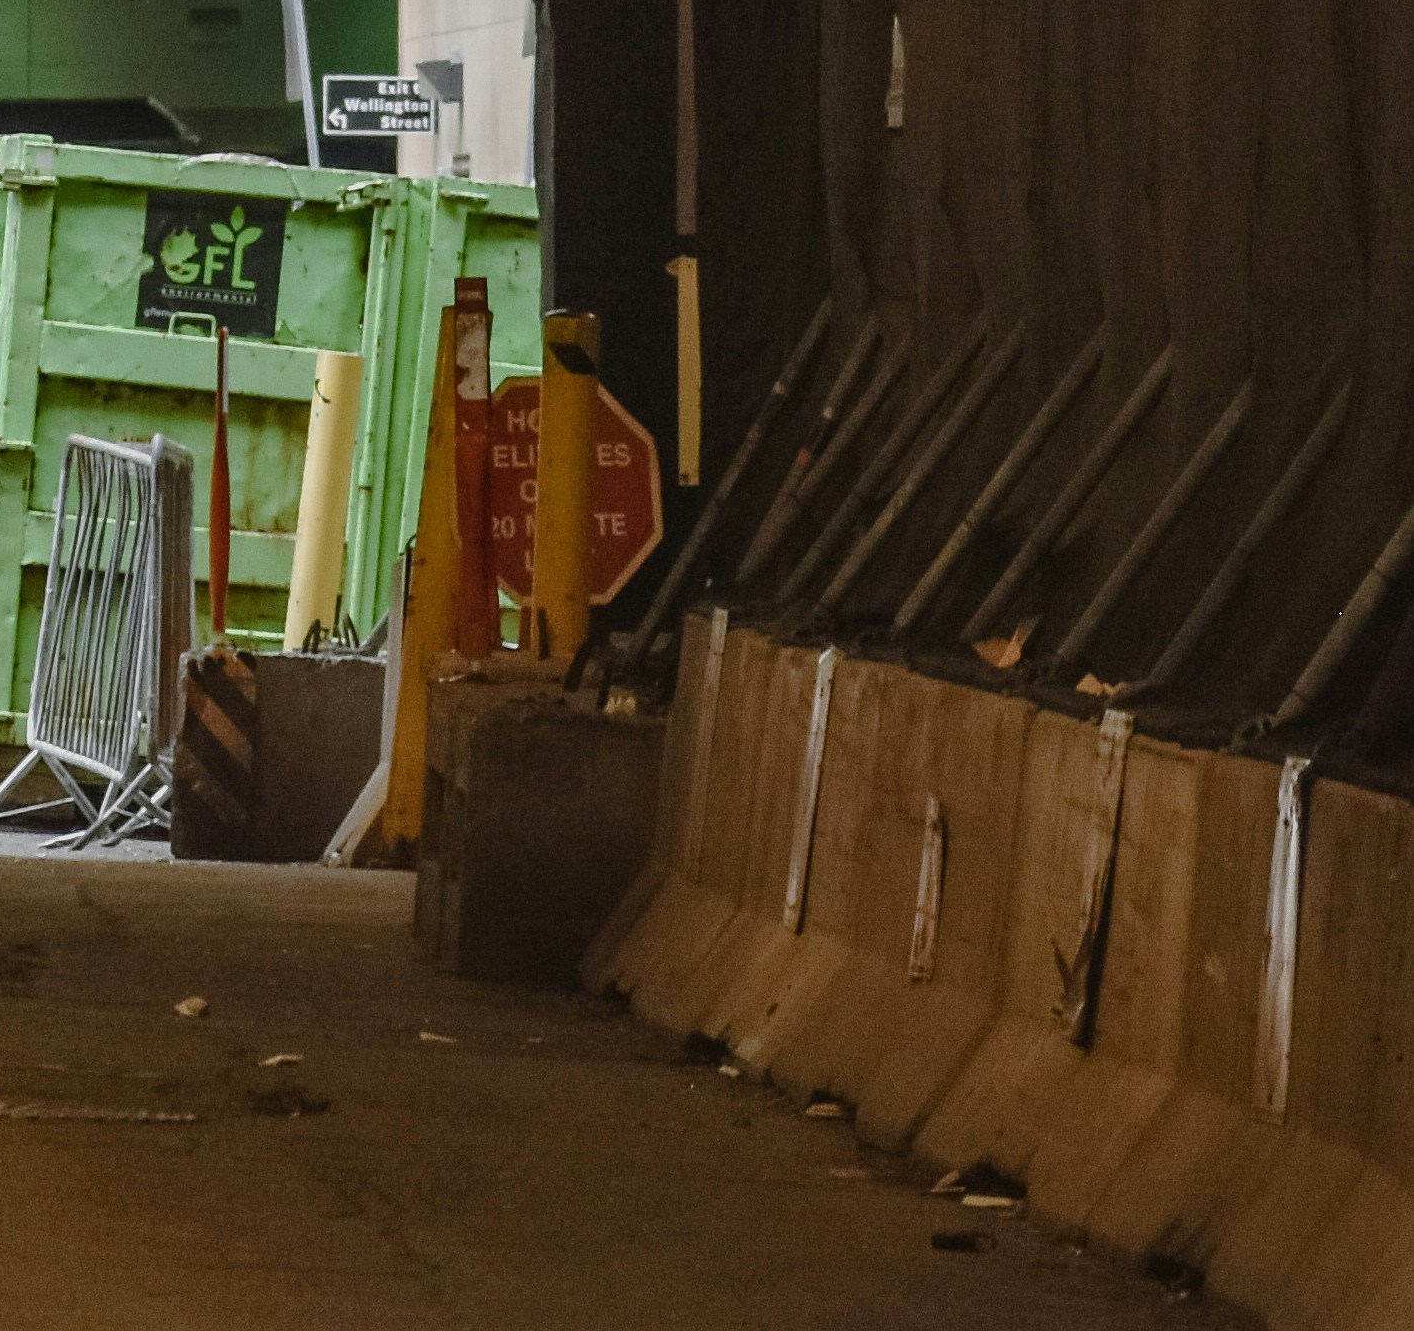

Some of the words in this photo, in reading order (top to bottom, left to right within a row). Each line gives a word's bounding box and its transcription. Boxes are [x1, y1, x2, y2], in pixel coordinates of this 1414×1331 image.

[378, 82, 409, 95] Exit
[344, 98, 429, 115] Wellington
[381, 115, 429, 129] Street
[160, 210, 263, 291] GFL
